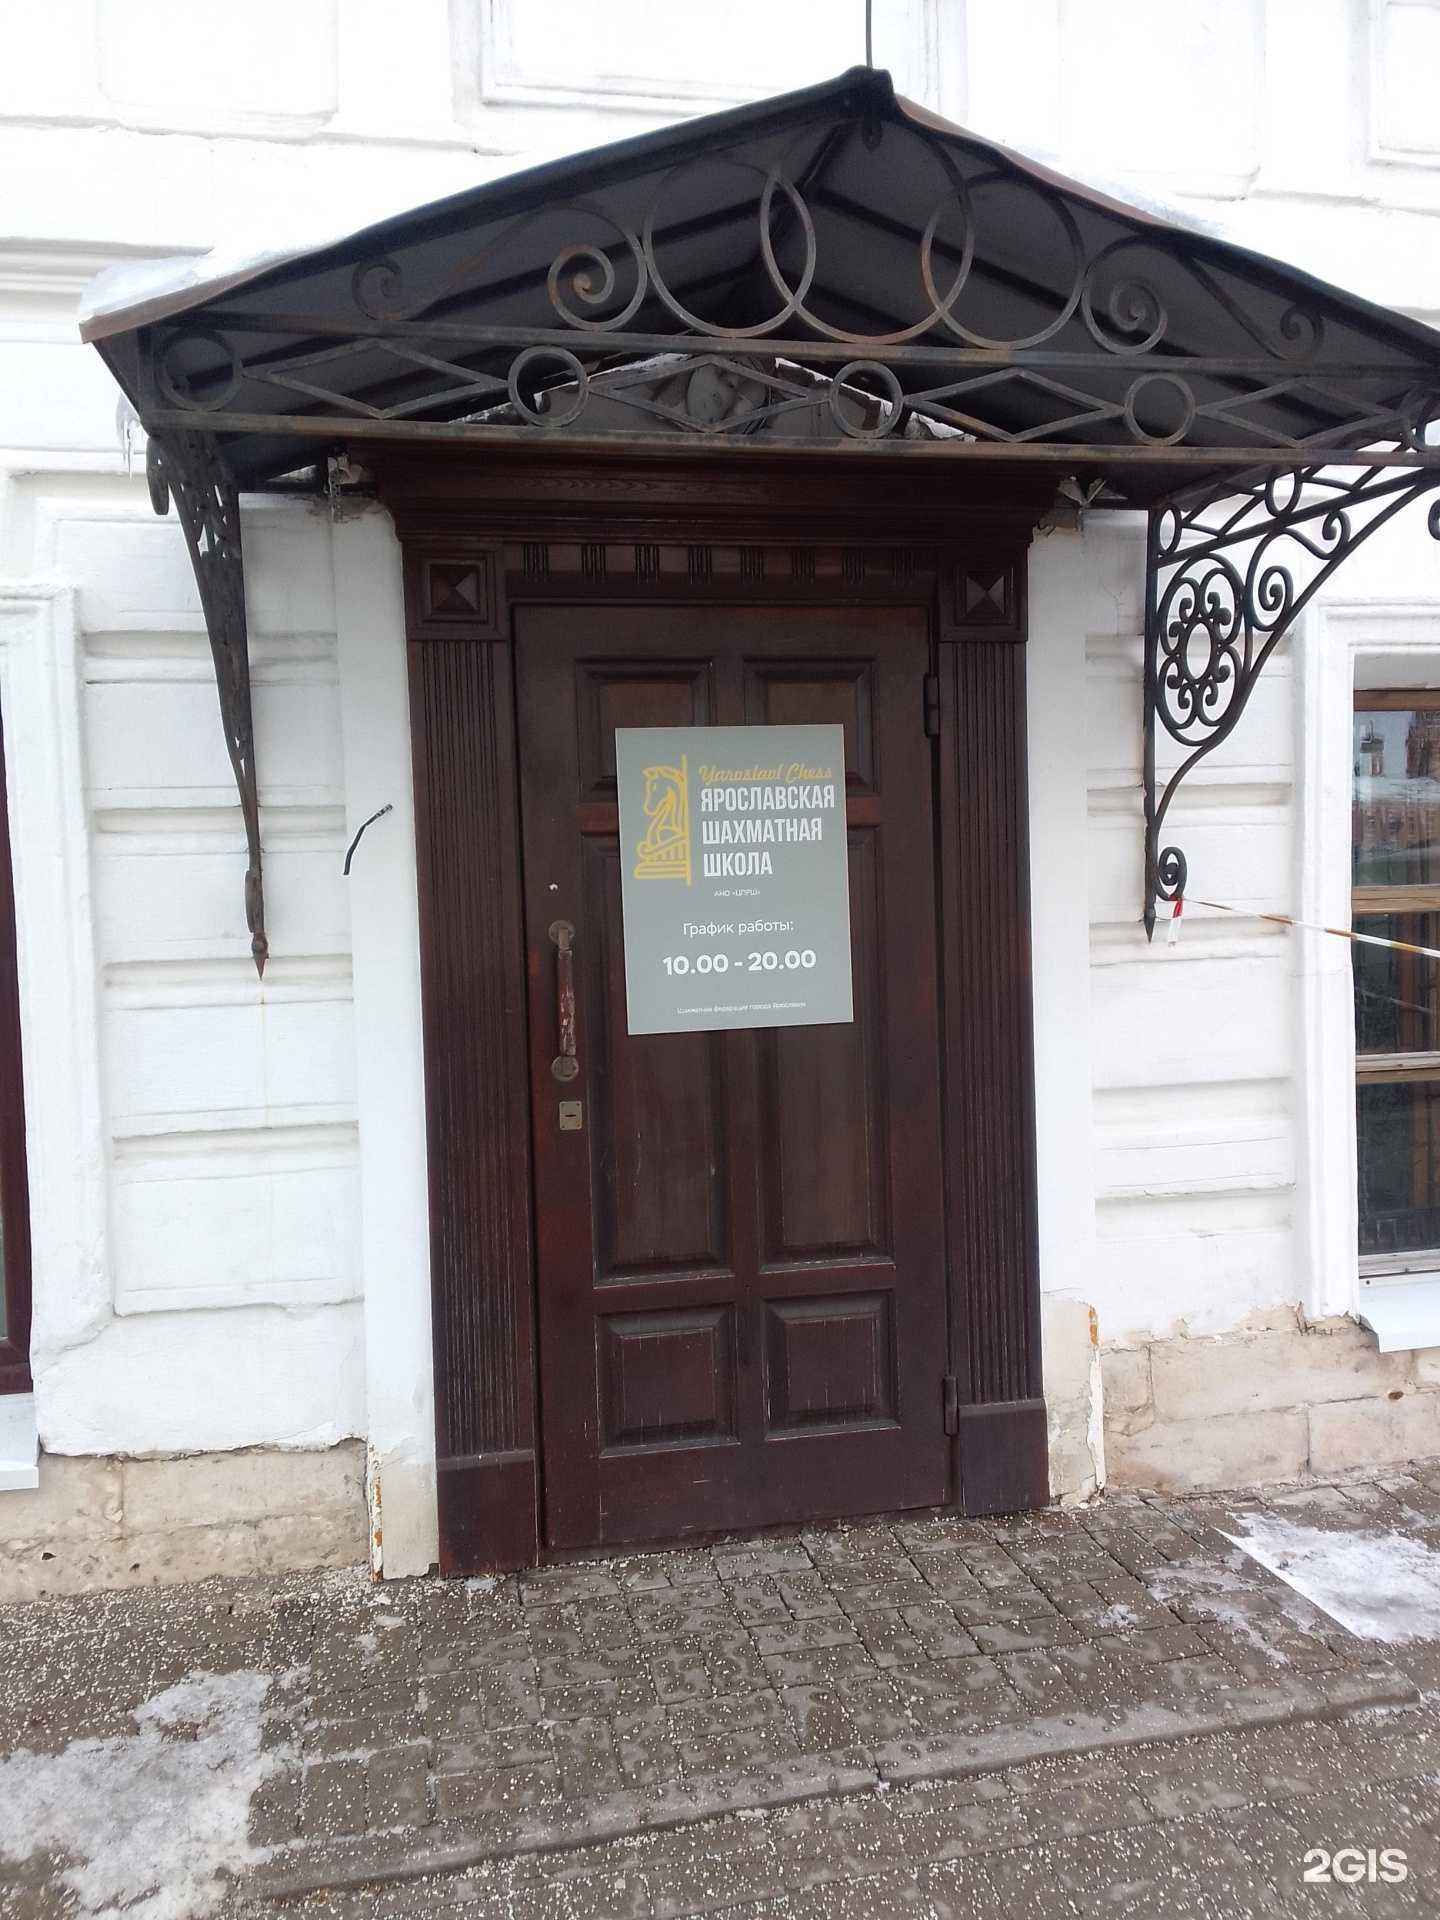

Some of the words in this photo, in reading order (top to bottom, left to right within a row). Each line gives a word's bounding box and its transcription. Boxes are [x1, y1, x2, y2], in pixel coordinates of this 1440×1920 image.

[785, 763, 833, 783] Chess
[701, 785, 835, 812] ЯРОСЛАВСКАЯ
[702, 817, 822, 844] ШАХМАТНАЯ
[704, 851, 773, 877] ШКОЛА
[683, 921, 735, 938] График
[738, 919, 794, 935] работы:
[662, 954, 729, 975] 10.00
[747, 950, 817, 971] 20.00
